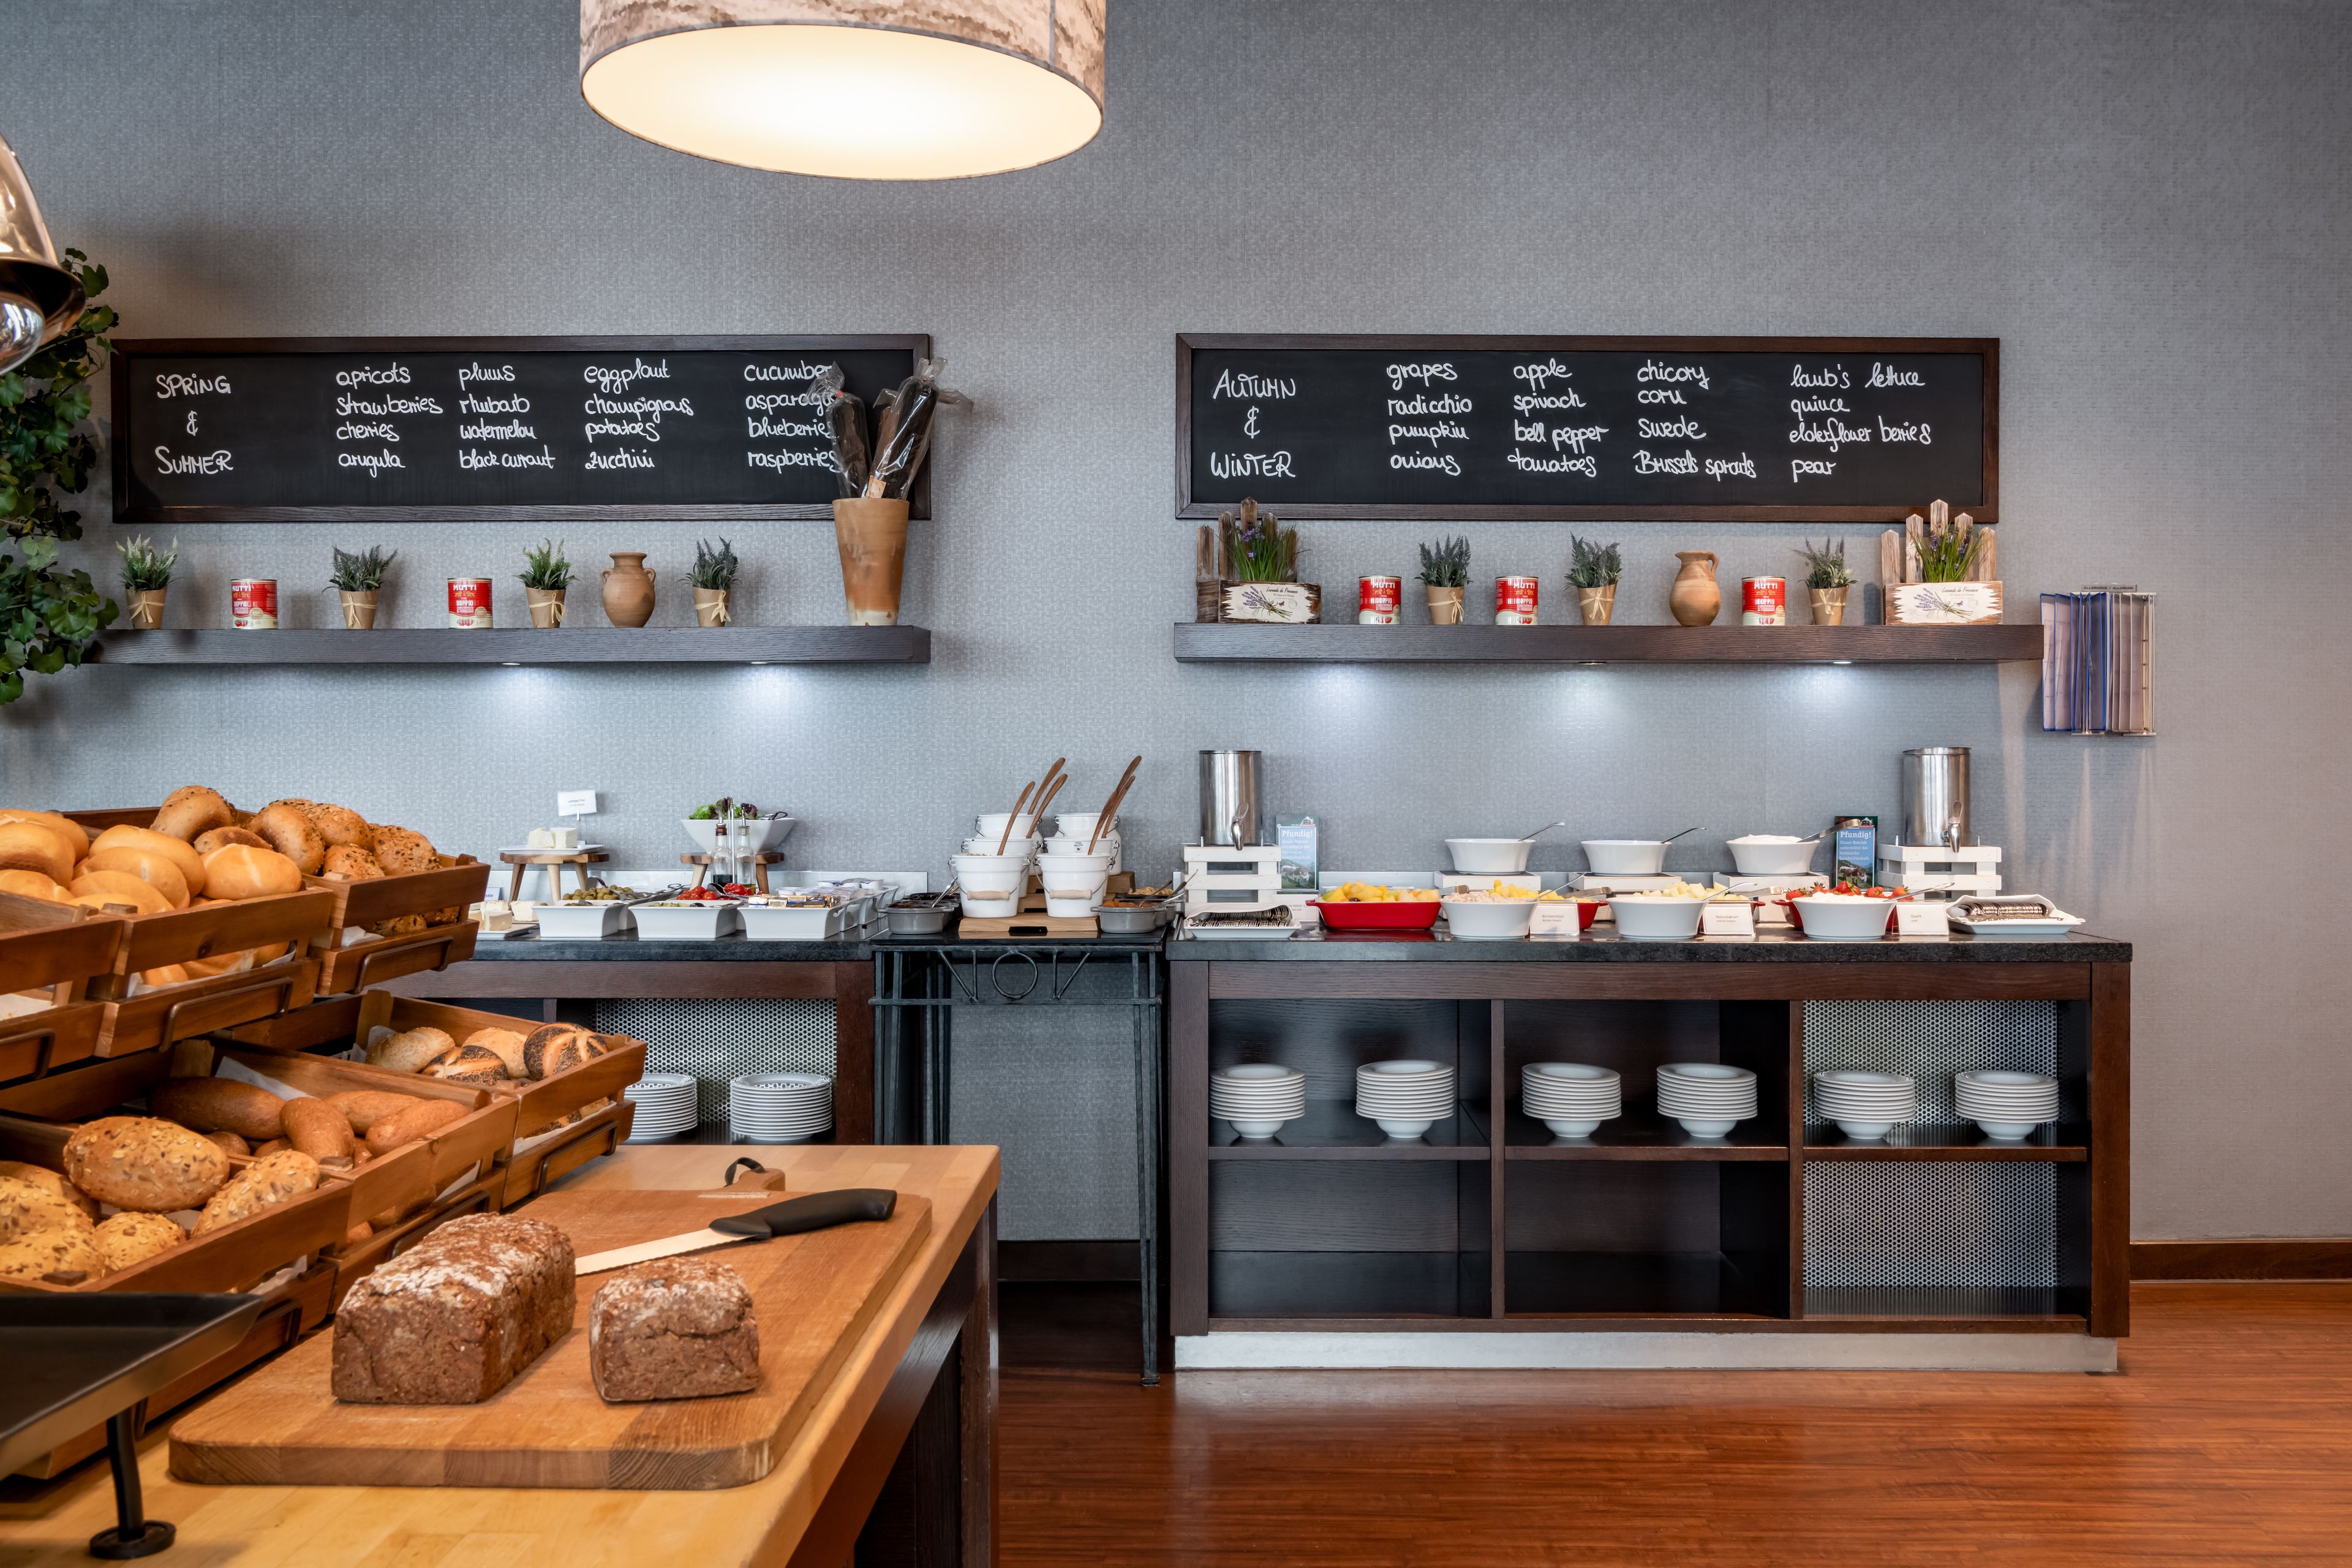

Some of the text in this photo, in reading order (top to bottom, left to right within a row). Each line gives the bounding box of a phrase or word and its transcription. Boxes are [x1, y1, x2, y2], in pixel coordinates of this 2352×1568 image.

[336, 362, 410, 389] apricots
[459, 362, 515, 391] plums
[584, 358, 671, 394] eggplant
[1213, 369, 1295, 399] AUTUMN
[1387, 363, 1457, 390] grapes
[1513, 358, 1572, 391] apple
[1637, 360, 1709, 390] chicory
[1790, 363, 1925, 388] lamb's lettuce
[336, 393, 443, 415] strawberries
[459, 393, 530, 413] rhubarb
[585, 393, 694, 423] champignons
[1388, 394, 1472, 416] radicchio
[1513, 388, 1586, 417] spinach
[1638, 390, 1687, 404] corn
[1791, 396, 1850, 421] quince
[187, 411, 198, 435] &
[336, 421, 399, 442] cherries
[460, 418, 537, 440] watermelon
[585, 418, 660, 443] potatoes
[1244, 405, 1260, 439] &
[1389, 421, 1469, 448] pumpkin
[1790, 415, 1931, 452] elderflower berries
[1515, 419, 1609, 454] bell pepper
[156, 446, 233, 474] SUMMER
[339, 448, 405, 478] arugula
[459, 445, 556, 470] black currant
[585, 448, 655, 469] zucchini
[748, 447, 843, 474] raspberries
[1390, 451, 1461, 476] onions
[1507, 448, 1596, 477] tomatoes
[1633, 450, 1756, 481] Brussels sprouts
[1791, 460, 1836, 483] pear
[1282, 830, 1313, 839] Pfundig!
[1840, 831, 1871, 840] Pfundig!
